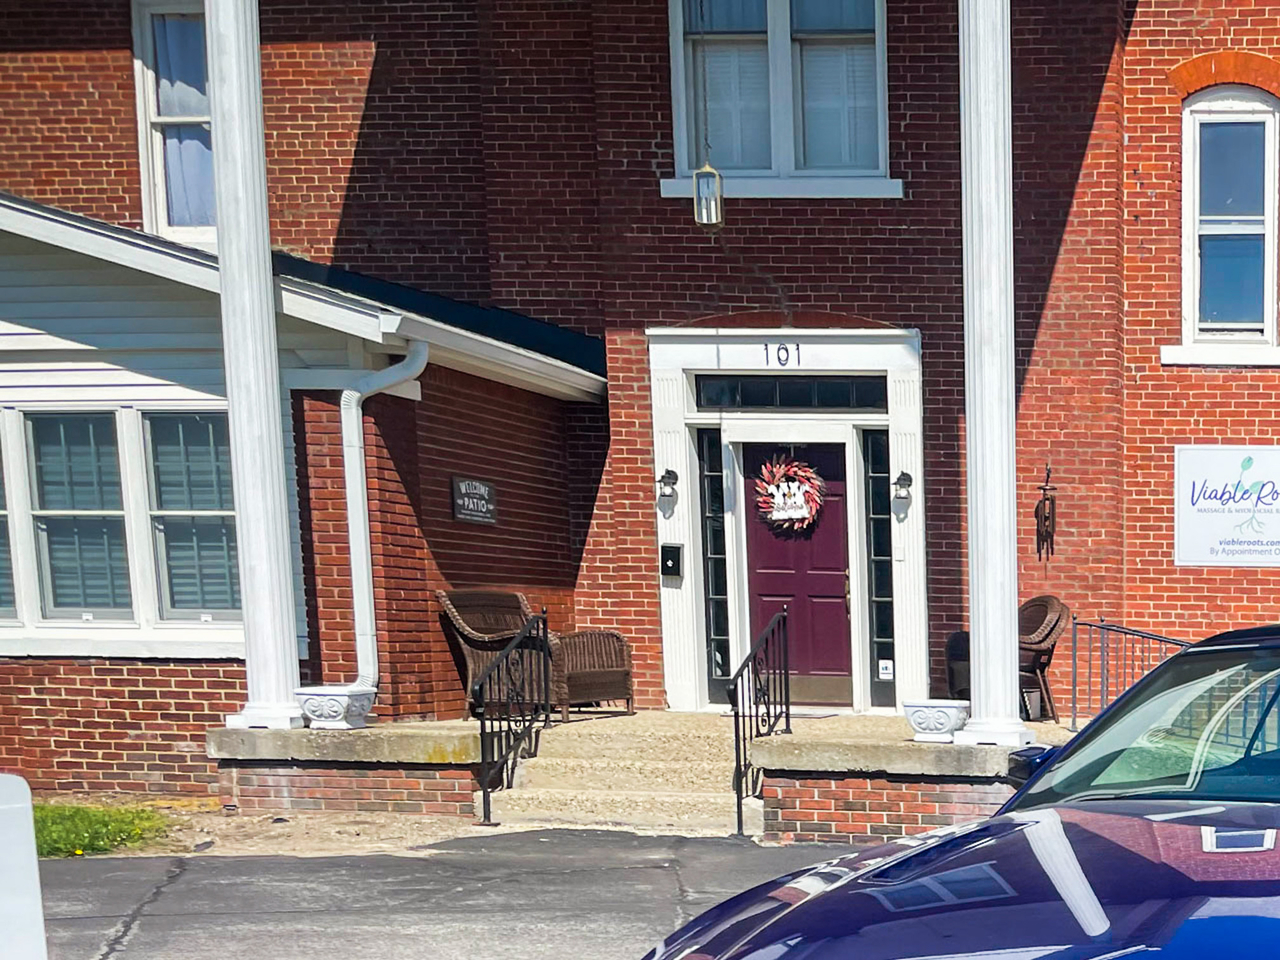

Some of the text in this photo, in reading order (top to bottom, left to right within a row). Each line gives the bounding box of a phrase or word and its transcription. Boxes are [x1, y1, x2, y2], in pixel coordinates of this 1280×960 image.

[763, 342, 801, 367] 101
[459, 481, 489, 499] WELCOME
[1190, 479, 1253, 507] Viable
[464, 497, 487, 512] PATIO
[1209, 547, 1220, 556] By
[1221, 547, 1272, 556] Appointment
